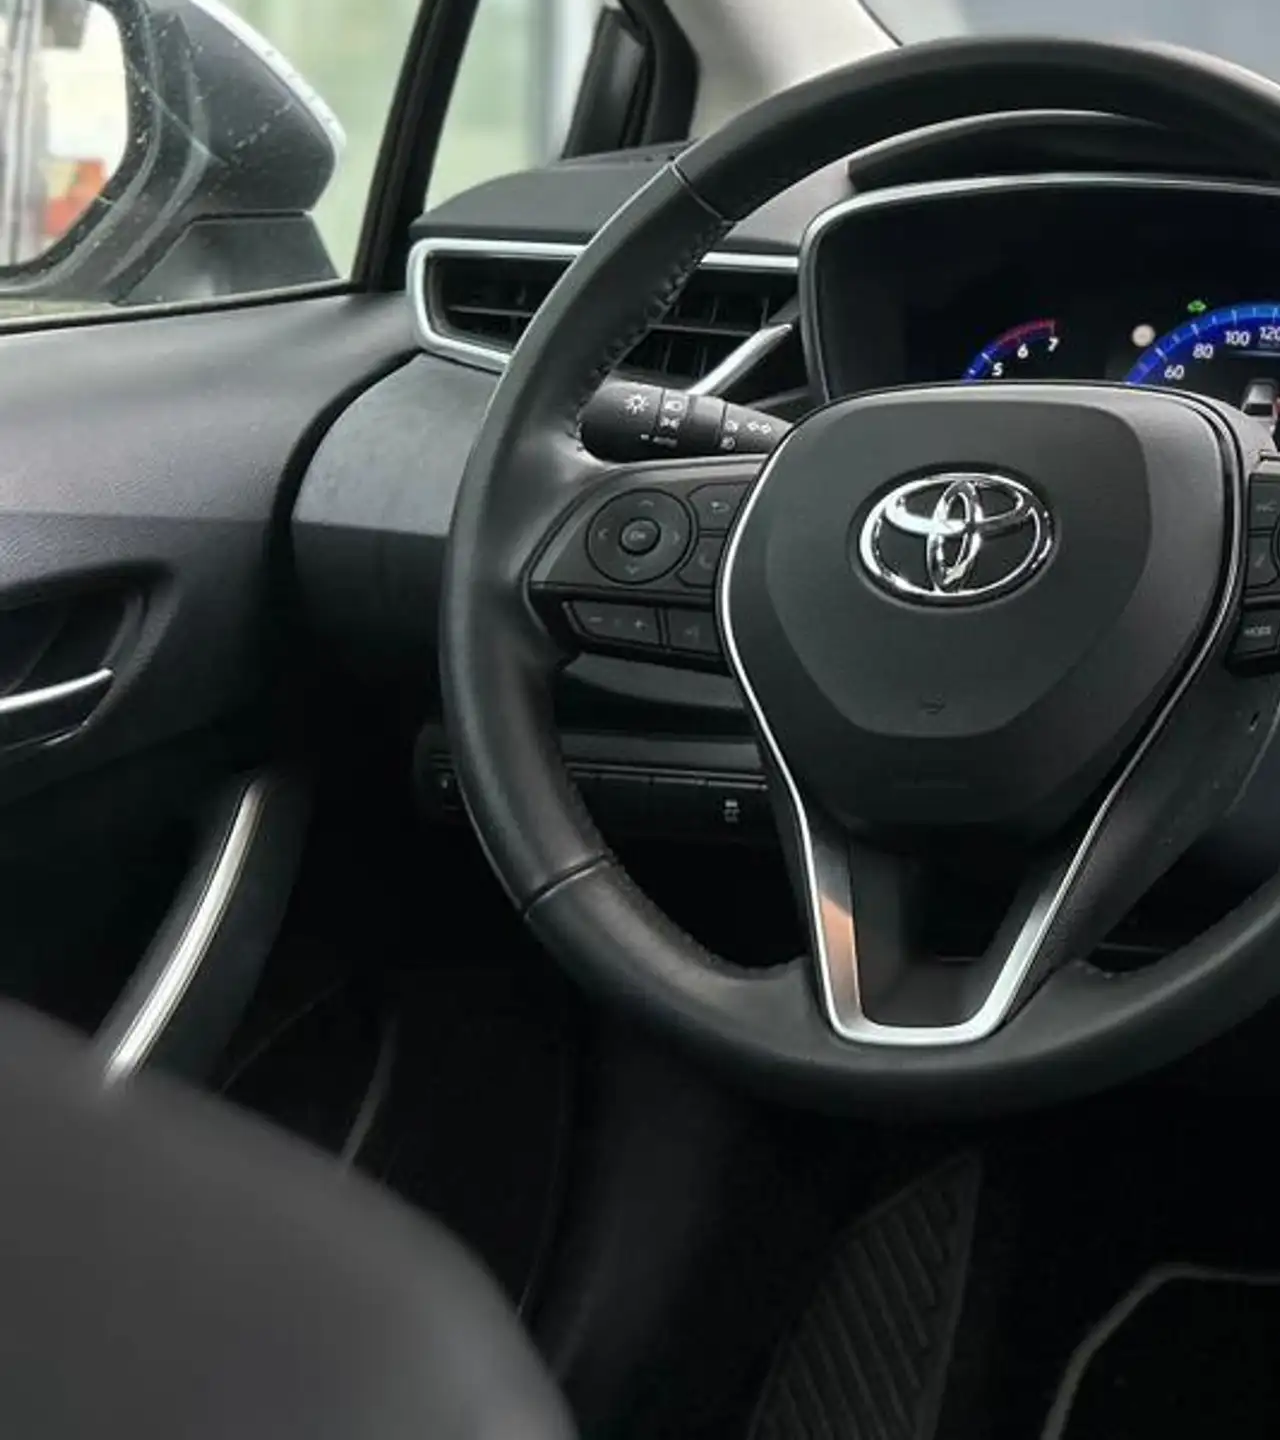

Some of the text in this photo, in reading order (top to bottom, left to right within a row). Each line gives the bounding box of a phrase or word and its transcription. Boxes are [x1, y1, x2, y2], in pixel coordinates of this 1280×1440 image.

[1047, 335, 1060, 353] 7
[1224, 331, 1251, 347] 100
[1017, 342, 1029, 360] 6
[1192, 343, 1214, 359] 80
[991, 361, 1004, 377] 5
[1164, 364, 1185, 380] 60
